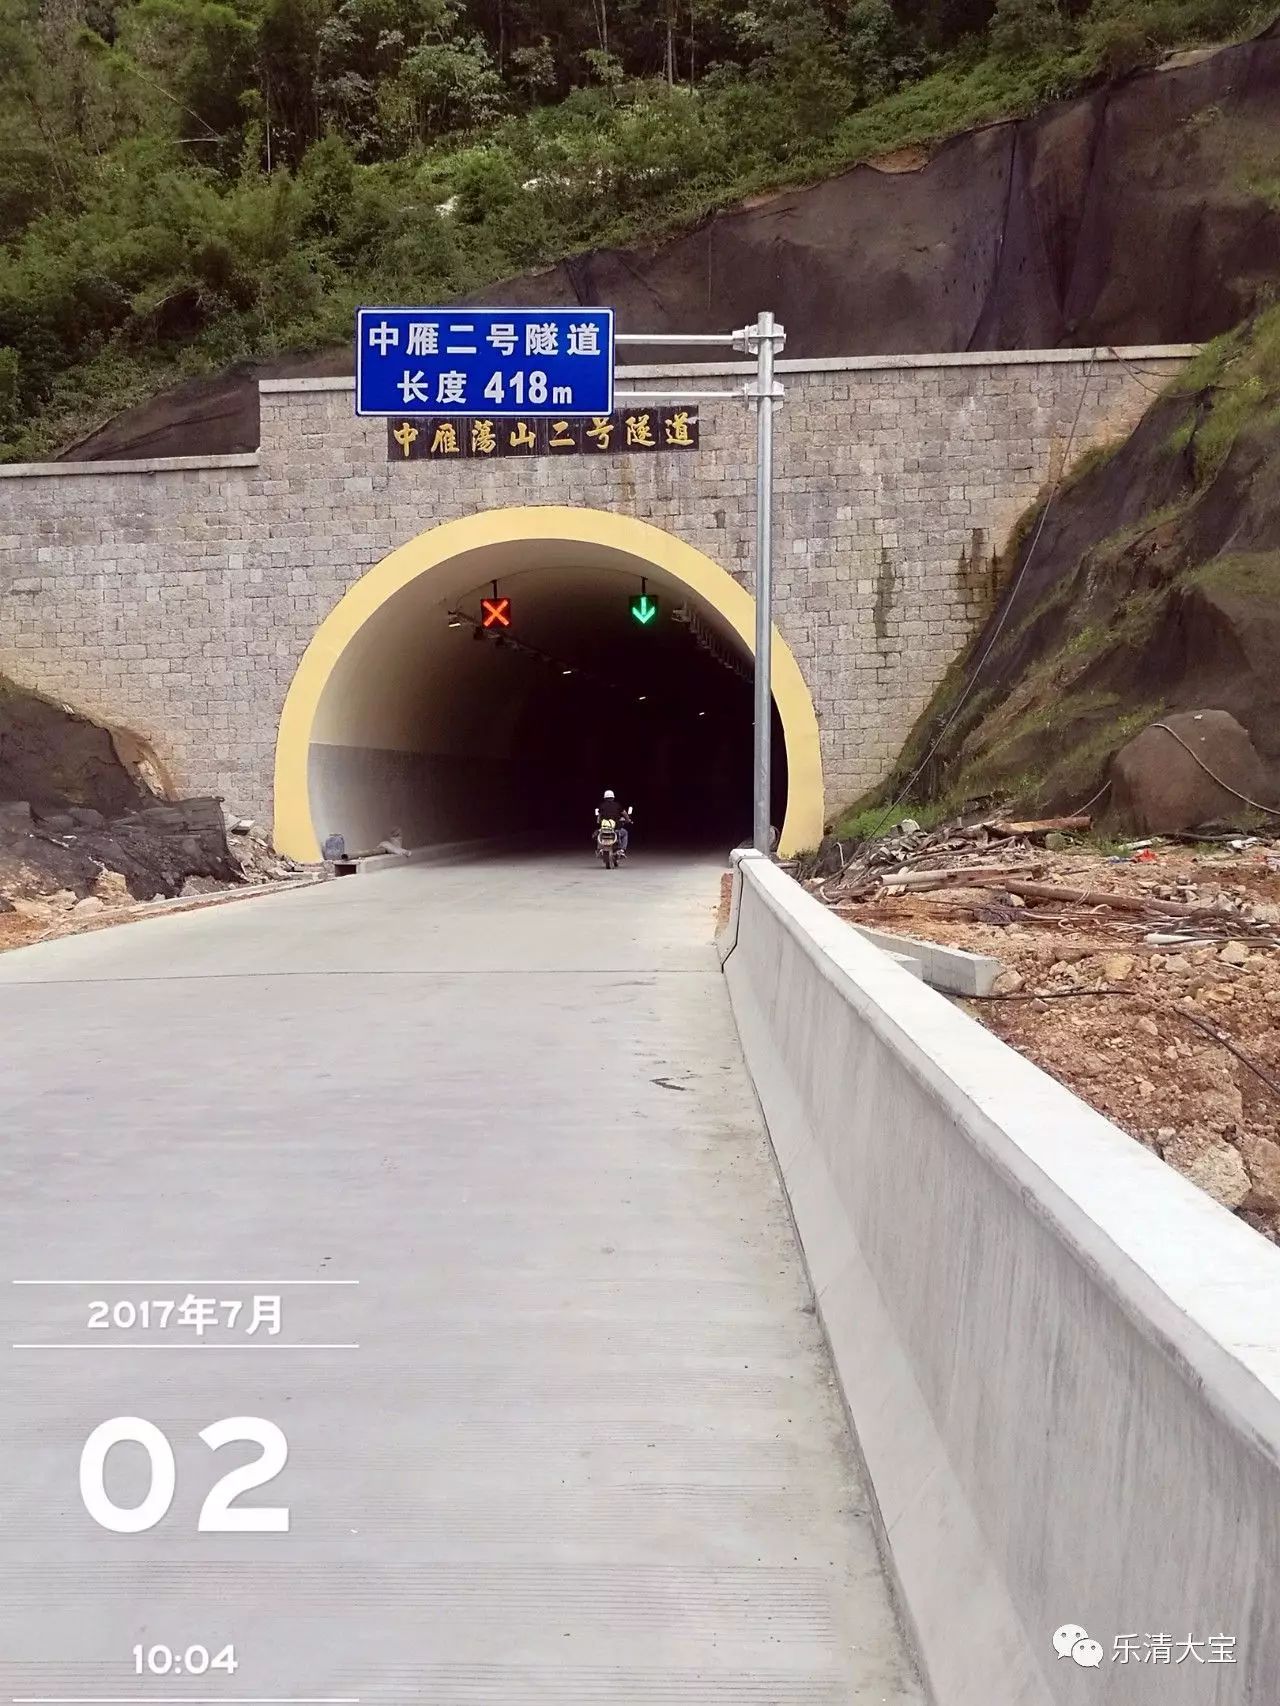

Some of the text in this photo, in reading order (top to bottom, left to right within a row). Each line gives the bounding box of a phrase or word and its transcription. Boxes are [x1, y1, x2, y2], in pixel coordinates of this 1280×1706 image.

[369, 321, 601, 356] 中雁二号隧道
[397, 370, 573, 404] 长度 418m
